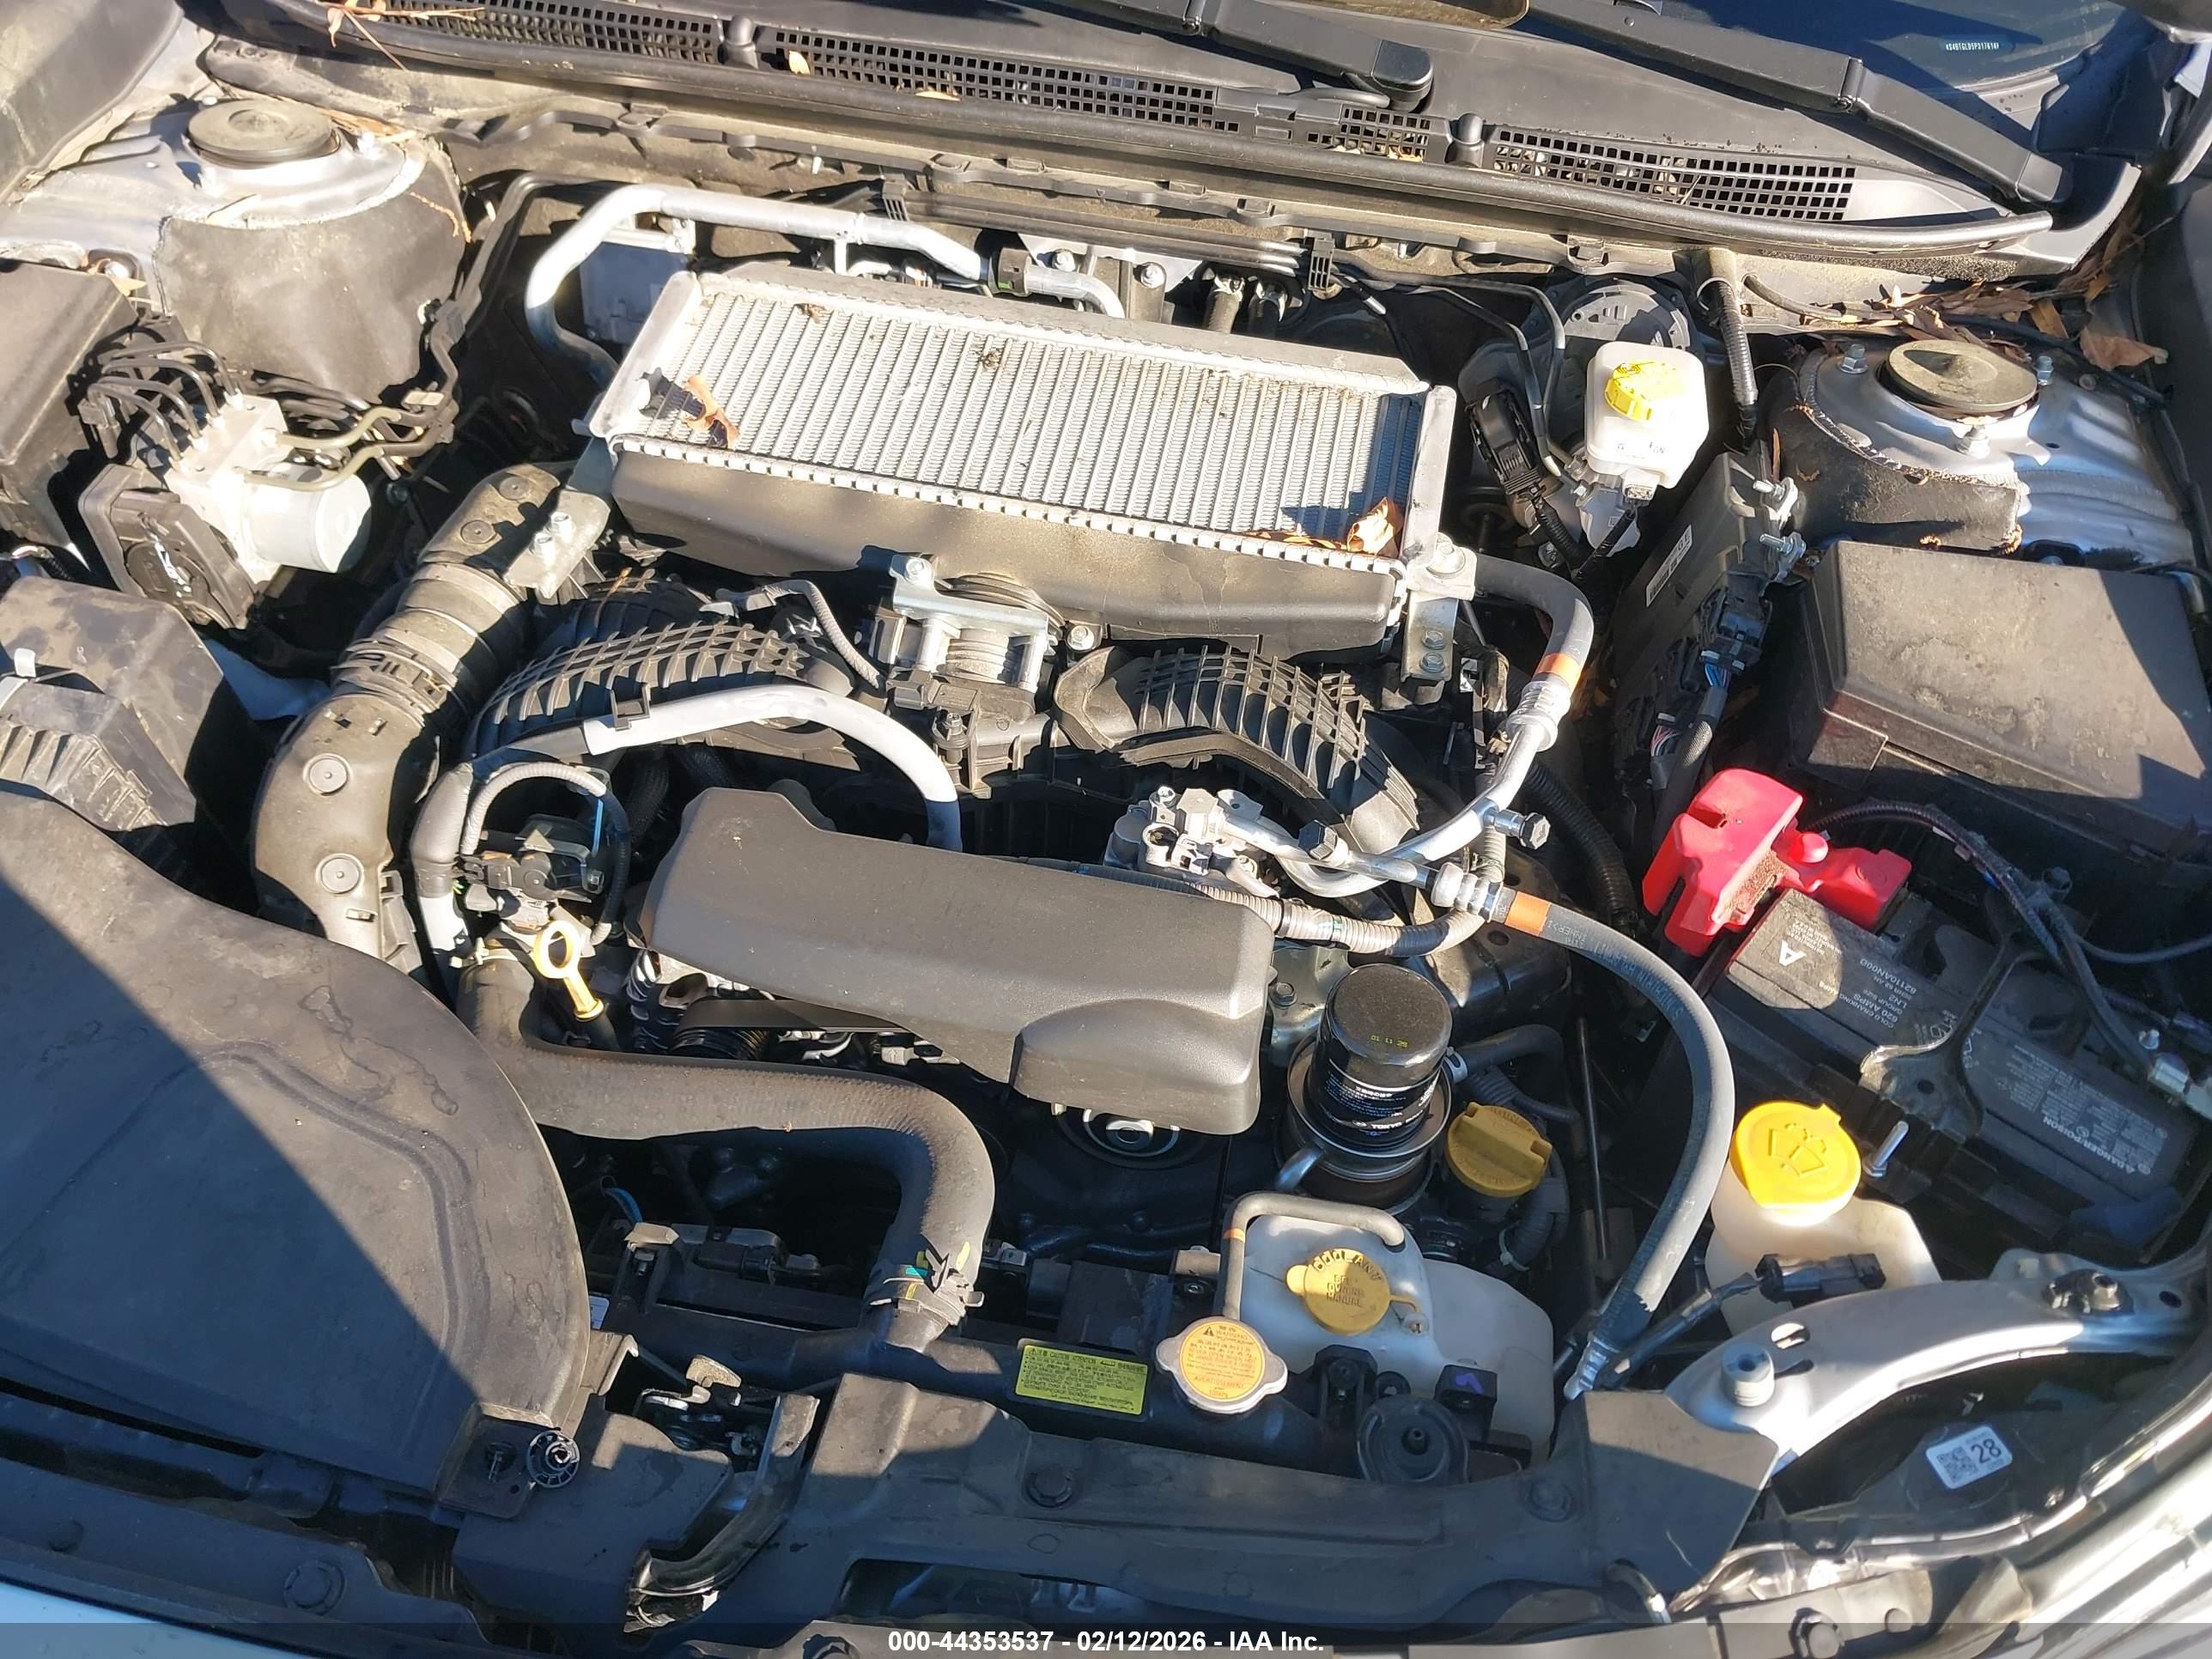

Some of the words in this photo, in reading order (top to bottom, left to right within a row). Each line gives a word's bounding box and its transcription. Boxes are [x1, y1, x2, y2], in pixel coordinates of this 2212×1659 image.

[1838, 993, 1874, 1017] CRANKING
[1852, 992, 1881, 1012] AMPS
[1877, 997, 1903, 1015] GROUP
[1887, 994, 1907, 1008] LN2
[1874, 1013, 1894, 1029] COLD
[1880, 1008, 1898, 1023] 620
[1971, 1438, 2001, 1464] 28
